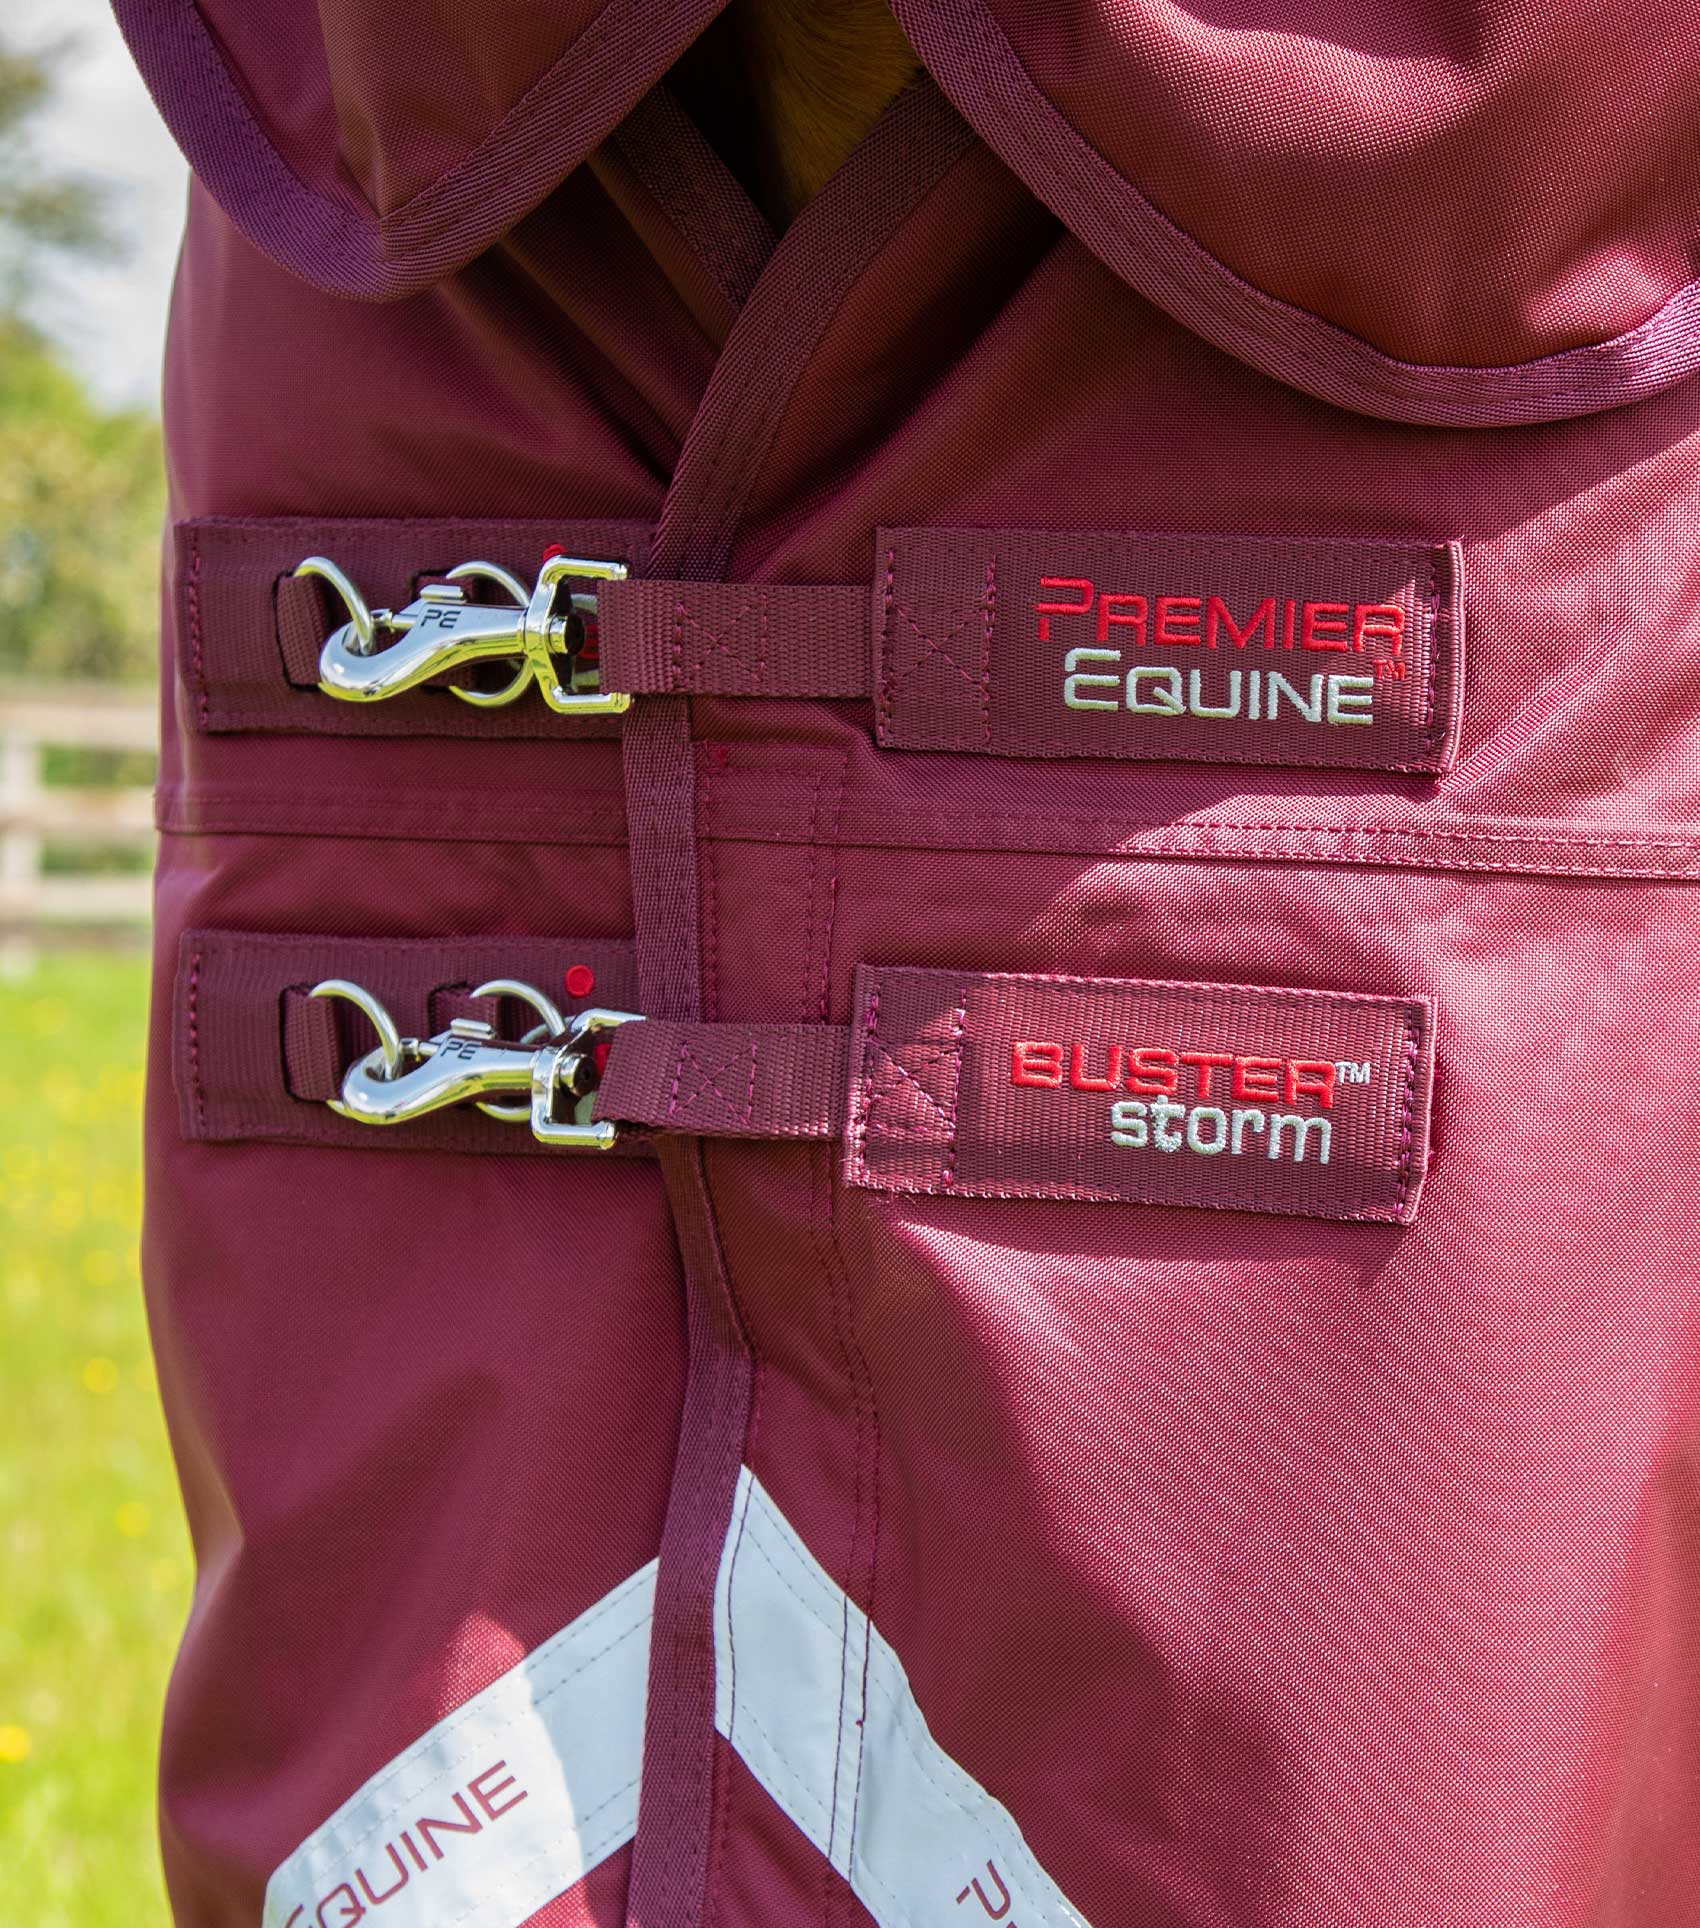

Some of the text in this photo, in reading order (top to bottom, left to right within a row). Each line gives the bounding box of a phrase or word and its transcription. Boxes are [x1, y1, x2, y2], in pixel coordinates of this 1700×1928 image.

[420, 608, 462, 629] PE
[1035, 576, 1405, 656] PREMIER
[440, 1041, 481, 1061] PE
[1110, 1094, 1333, 1165] storm
